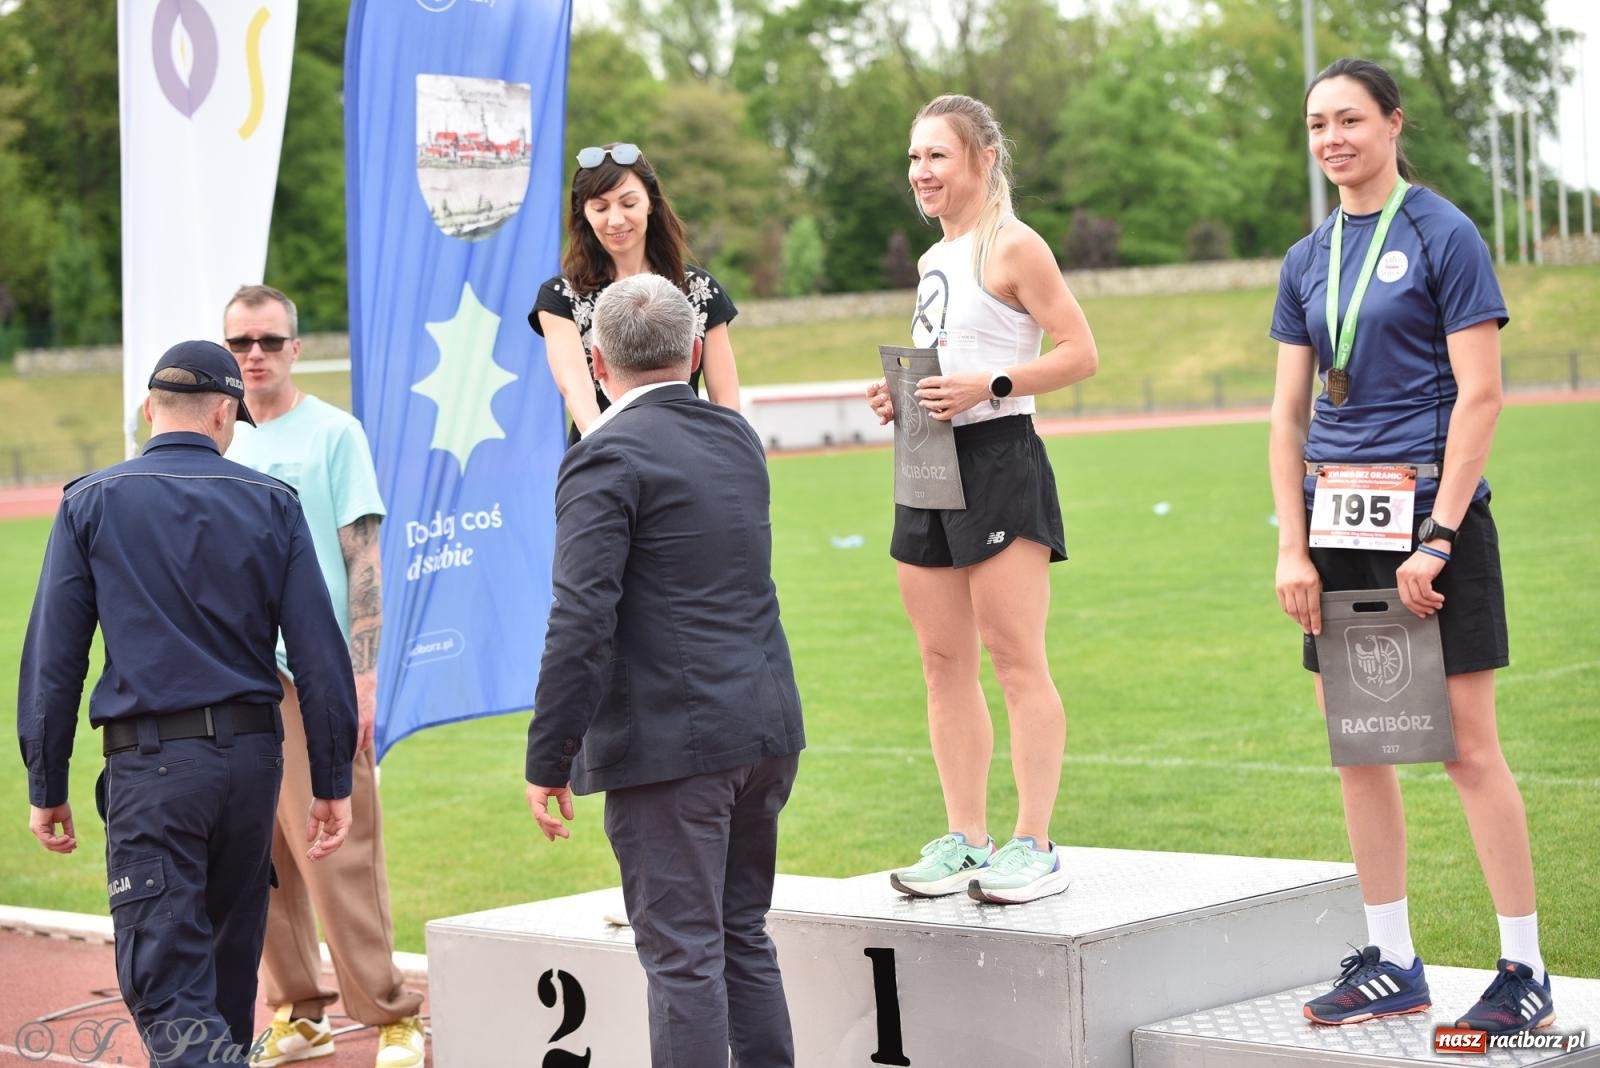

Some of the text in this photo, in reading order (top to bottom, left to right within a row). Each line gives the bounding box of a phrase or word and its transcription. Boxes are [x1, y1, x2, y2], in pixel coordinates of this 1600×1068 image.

[461, 503, 503, 531] coś
[1332, 494, 1391, 527] 195
[1341, 709, 1434, 734] RACIBÓRZ
[1382, 745, 1400, 753] 1217
[537, 968, 591, 1068] 2
[863, 947, 911, 1067] 1
